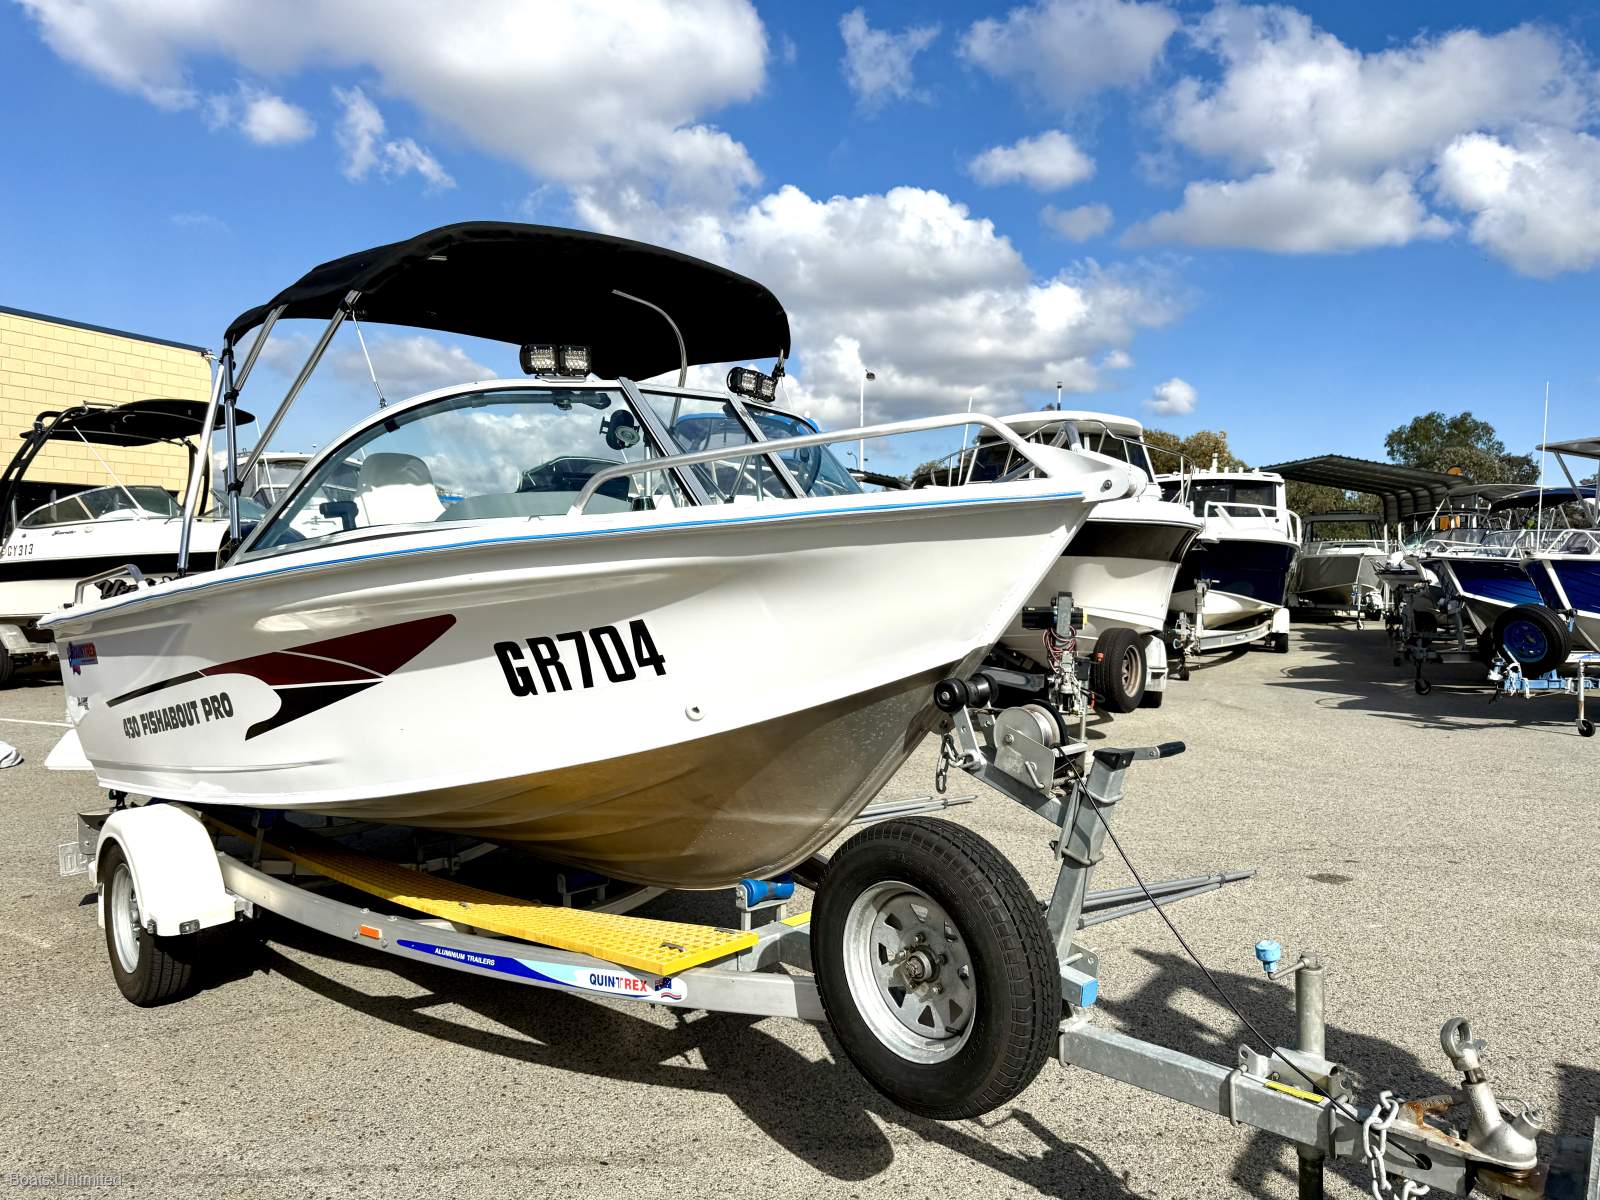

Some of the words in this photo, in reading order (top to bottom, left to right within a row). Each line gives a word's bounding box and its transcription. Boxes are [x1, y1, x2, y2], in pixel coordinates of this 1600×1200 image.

[493, 619, 667, 697] GR704
[122, 715, 141, 739] 430
[140, 700, 201, 736] FISHABOUT
[200, 692, 234, 722] PRO
[434, 947, 466, 960] ALUMINIUM
[466, 954, 496, 966] TRAILERS
[589, 973, 648, 993] QUINTREX
